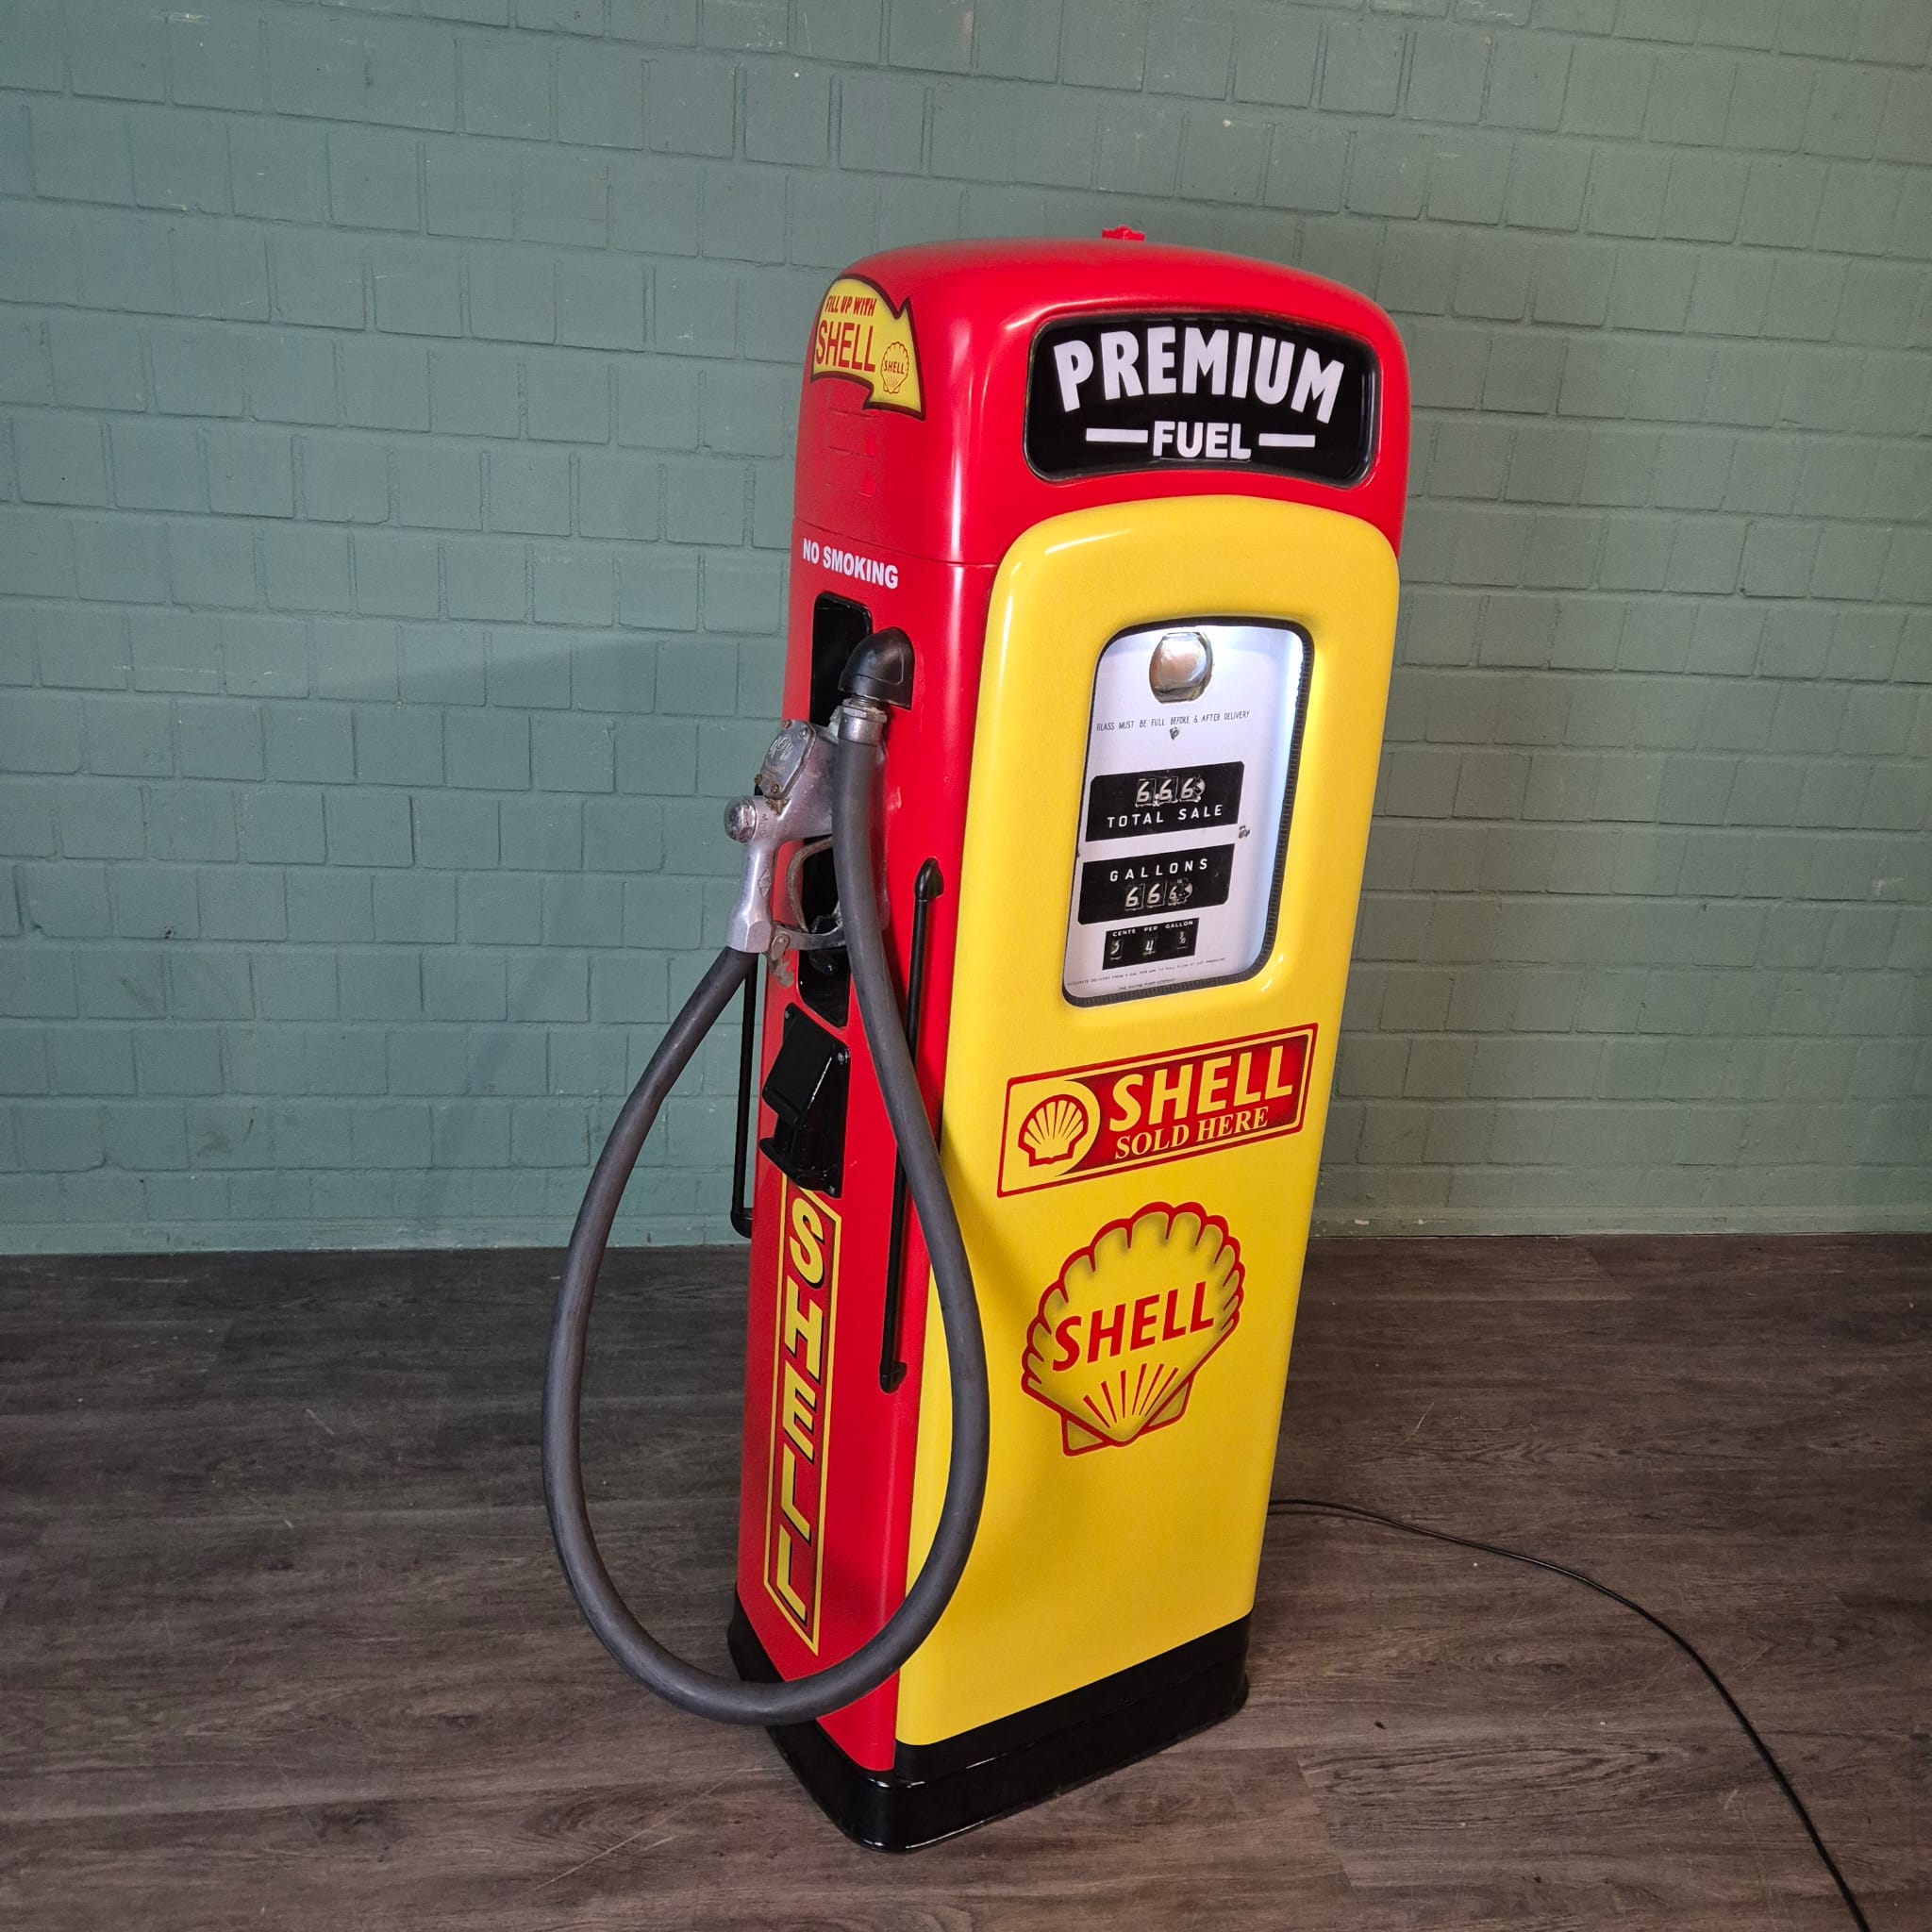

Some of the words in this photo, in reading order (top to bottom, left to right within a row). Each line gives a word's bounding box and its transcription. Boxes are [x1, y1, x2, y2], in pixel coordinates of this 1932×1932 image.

[841, 296, 853, 314] UP
[853, 297, 877, 317] WITH
[816, 320, 875, 373] SHELL
[884, 360, 905, 375] SHELL
[1054, 326, 1344, 425] PREMIUM
[1153, 421, 1251, 459] FUEL
[803, 538, 819, 564] NO
[823, 546, 898, 589] SMOKING
[1096, 722, 1114, 731] GLASS
[1119, 720, 1135, 730] MUST
[1139, 719, 1147, 728] BE
[1151, 718, 1165, 726] FULL
[1170, 716, 1190, 725] BEFORE
[1201, 713, 1220, 723] AFTER
[1224, 710, 1250, 721] DELIVERY
[1107, 811, 1164, 828] TOTAL
[1177, 804, 1224, 821] SALE
[1110, 858, 1208, 882] GALLONS
[1112, 928, 1137, 937] CENTS
[1165, 920, 1193, 929] GALLON
[1109, 1045, 1292, 1132] SHELL
[1115, 1122, 1190, 1160] SOLD
[1194, 1107, 1269, 1143] HERE
[1052, 1281, 1214, 1372] SHELL
[776, 1197, 824, 1624] SHELL
